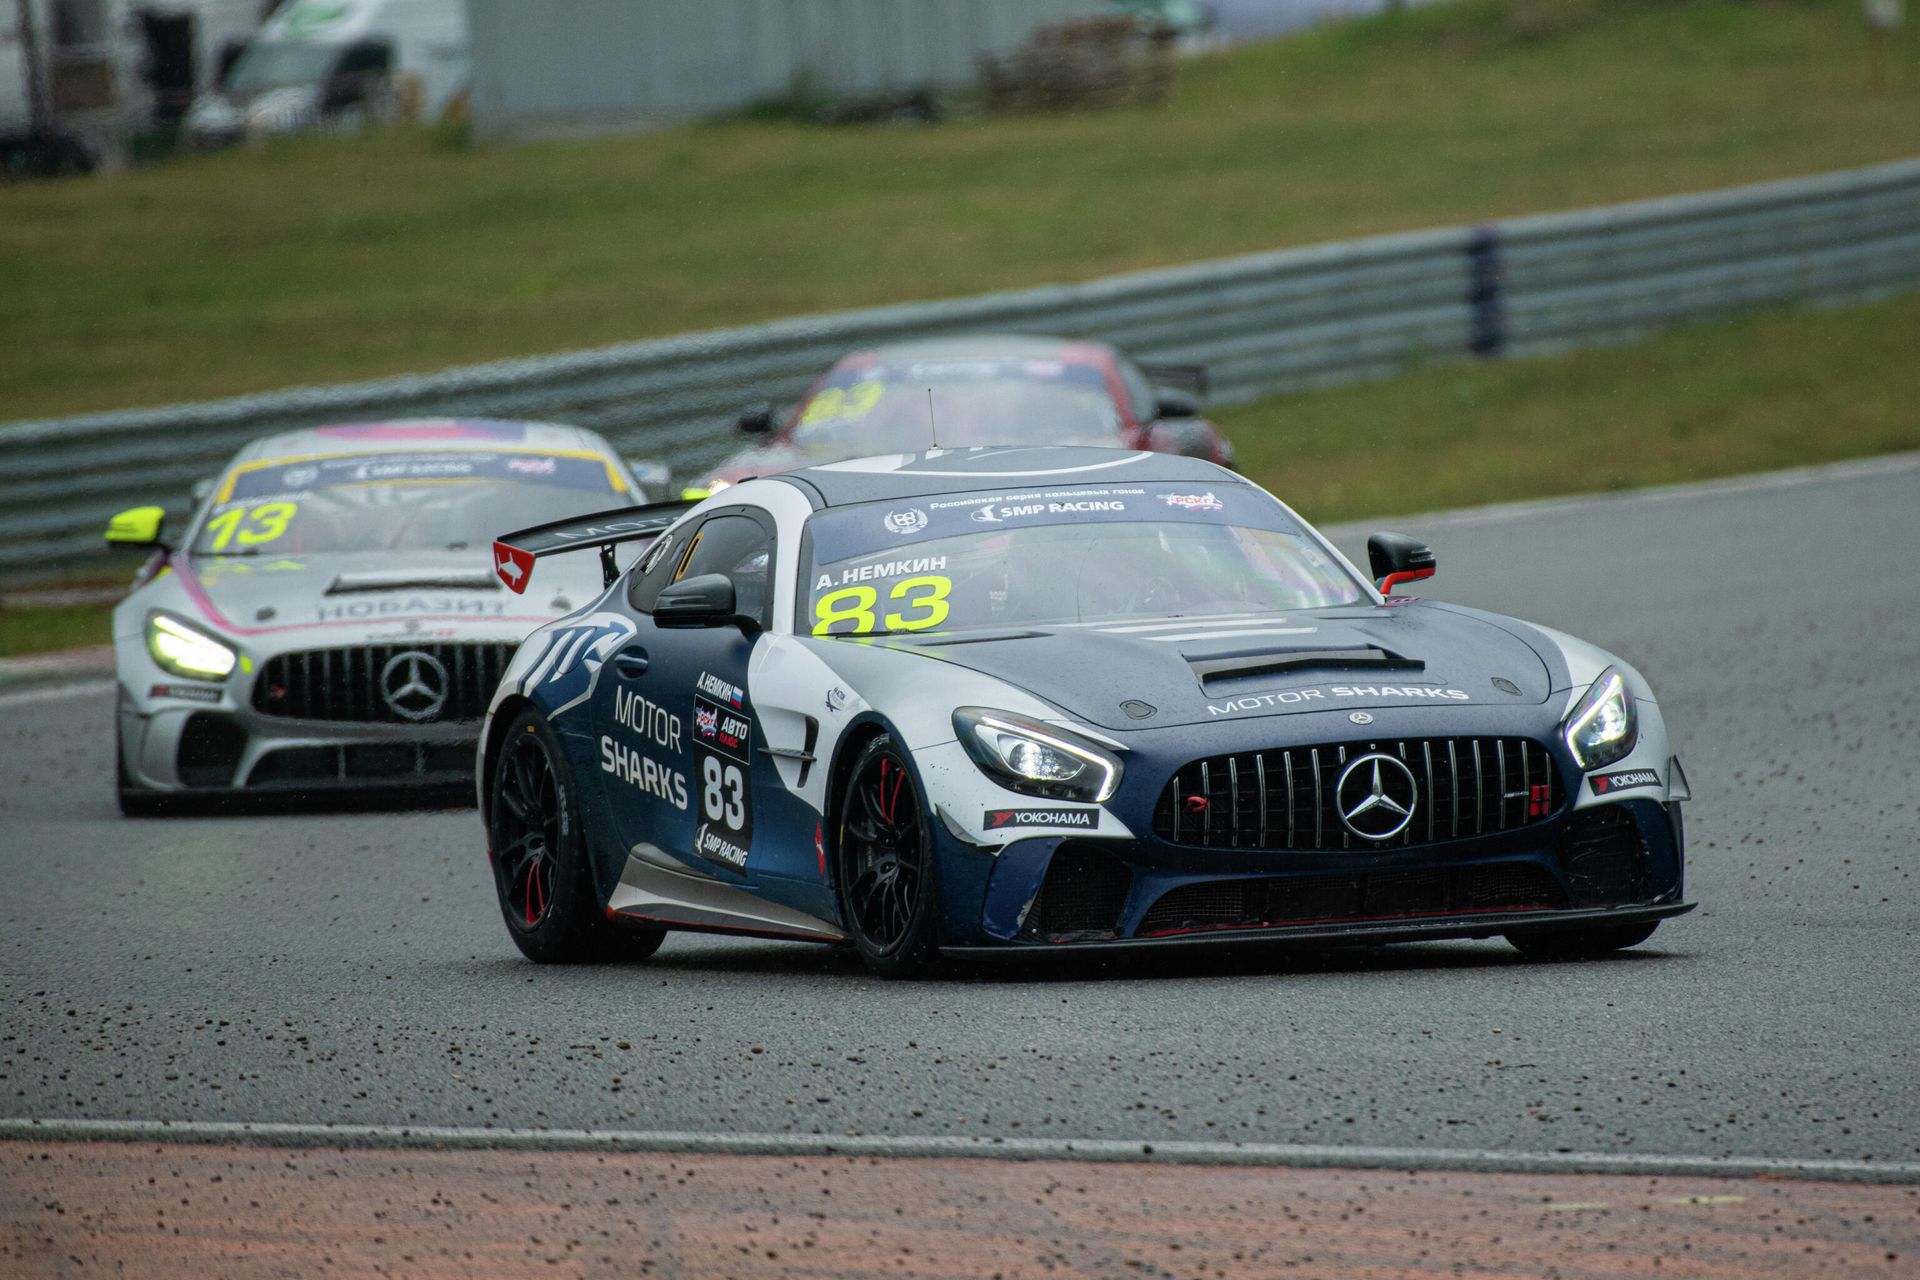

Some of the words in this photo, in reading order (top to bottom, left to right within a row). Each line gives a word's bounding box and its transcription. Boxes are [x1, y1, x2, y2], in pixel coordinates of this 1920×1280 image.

[930, 496, 1002, 510] Российская
[1006, 493, 1042, 502] серия
[1045, 489, 1109, 498] кольцевых
[1000, 504, 1045, 518] SMP
[1048, 500, 1125, 513] RACING
[207, 502, 298, 550] 13
[554, 516, 680, 539] MOT
[811, 575, 952, 635] 83
[1206, 688, 1326, 717] MOTOR
[1330, 685, 1470, 701] SHARKS
[614, 684, 683, 755] MOTOR
[720, 715, 749, 741] АВТО
[600, 735, 689, 811] SHARKS
[1608, 772, 1658, 788] YOKOHAMA
[703, 755, 745, 831] 83
[1015, 812, 1091, 825] YOKOHAMA
[703, 832, 723, 853] SMP
[718, 840, 748, 867] RACING
